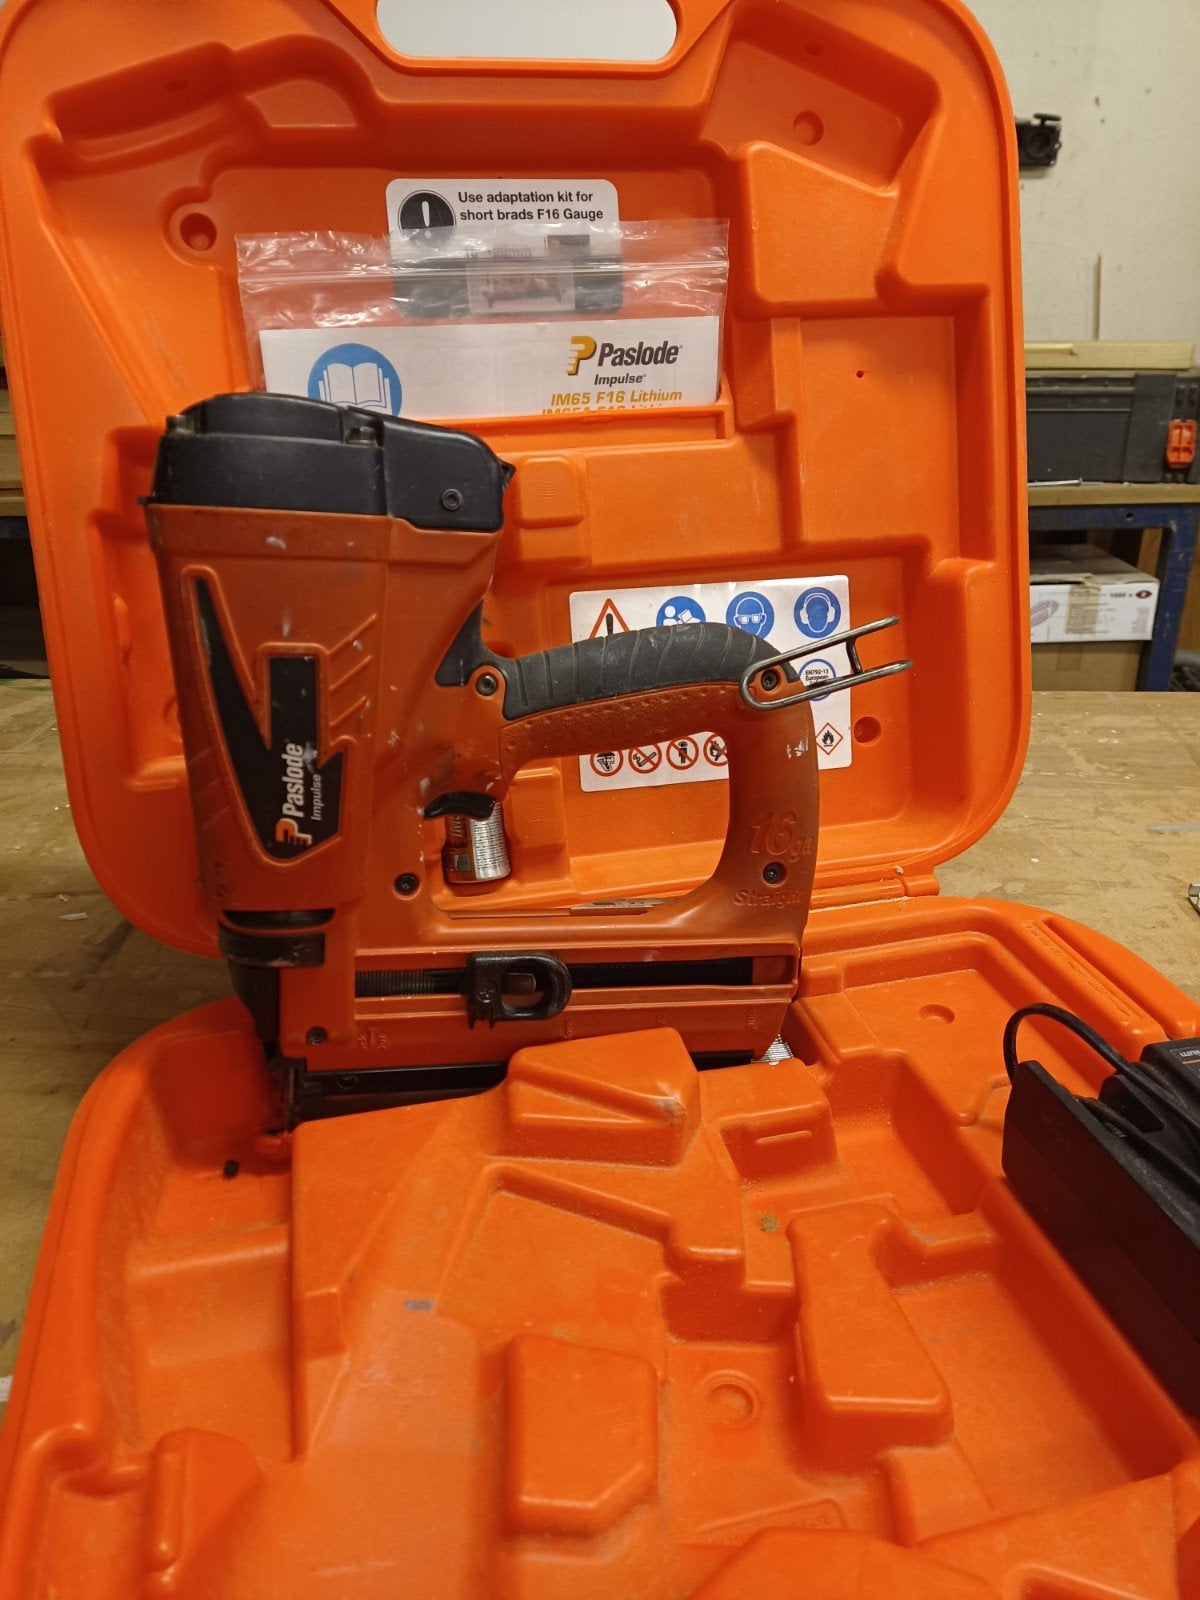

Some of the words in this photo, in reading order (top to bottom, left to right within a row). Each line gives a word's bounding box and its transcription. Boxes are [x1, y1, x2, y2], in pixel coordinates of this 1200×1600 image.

[458, 191, 483, 203] Use
[486, 191, 554, 205] adaptation
[557, 191, 573, 202] kit
[576, 191, 594, 202] for
[460, 208, 494, 221] short
[497, 208, 534, 220] brads
[537, 208, 560, 220] F16
[563, 208, 604, 222] Gauge
[597, 340, 680, 367] Paslode
[594, 373, 644, 387] Impulse
[550, 392, 591, 406] IM65
[596, 390, 625, 404] F16
[630, 388, 682, 403] Lithium
[281, 742, 304, 818] Paslode
[310, 773, 324, 821] Impulse
